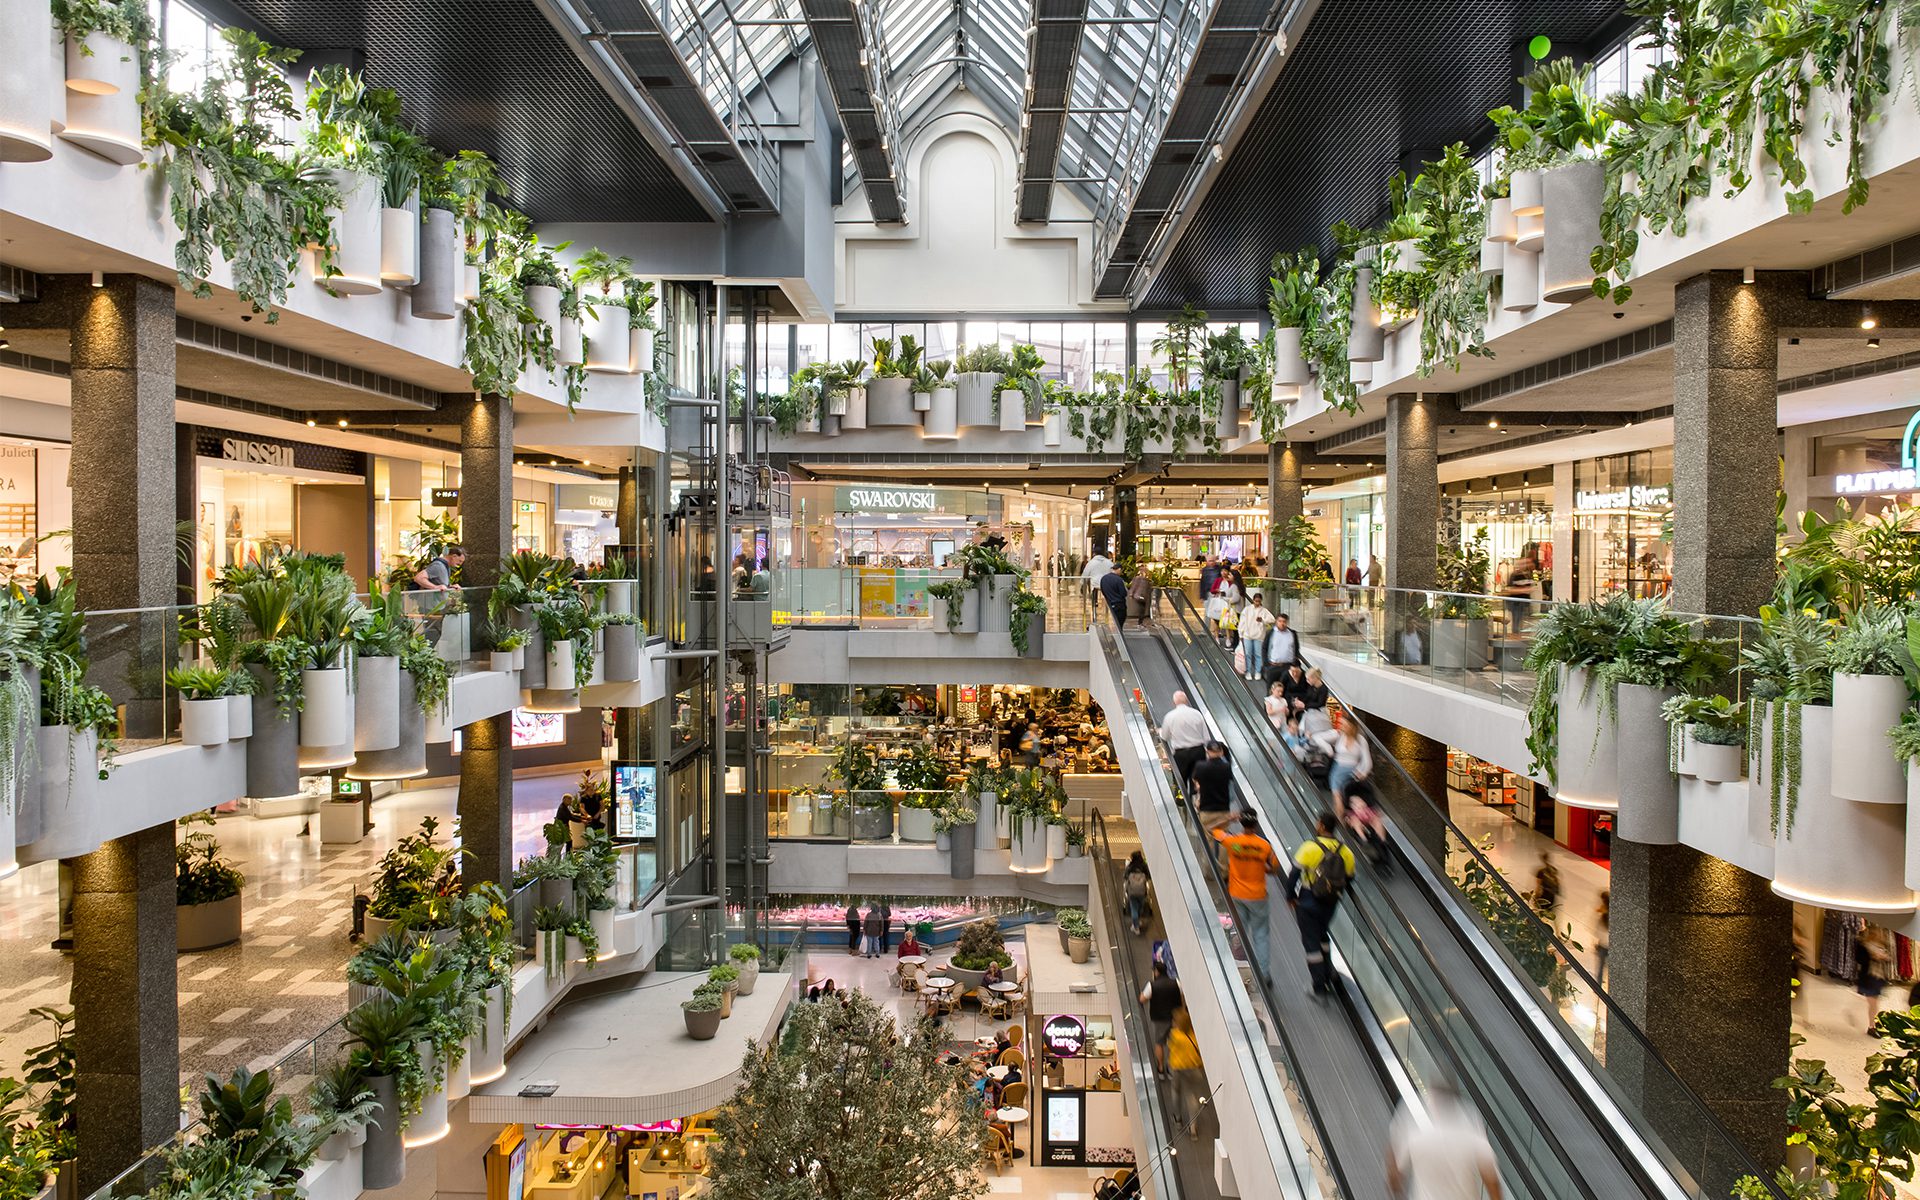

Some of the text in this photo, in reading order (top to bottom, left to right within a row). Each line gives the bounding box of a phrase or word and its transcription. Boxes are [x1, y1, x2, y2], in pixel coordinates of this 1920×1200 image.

[223, 438, 295, 468] sussan
[1836, 469, 1916, 493] PLATYPUS
[850, 490, 935, 509] SWAROVSKI
[1577, 486, 1669, 510] Universal Store
[1045, 1023, 1081, 1037] donut
